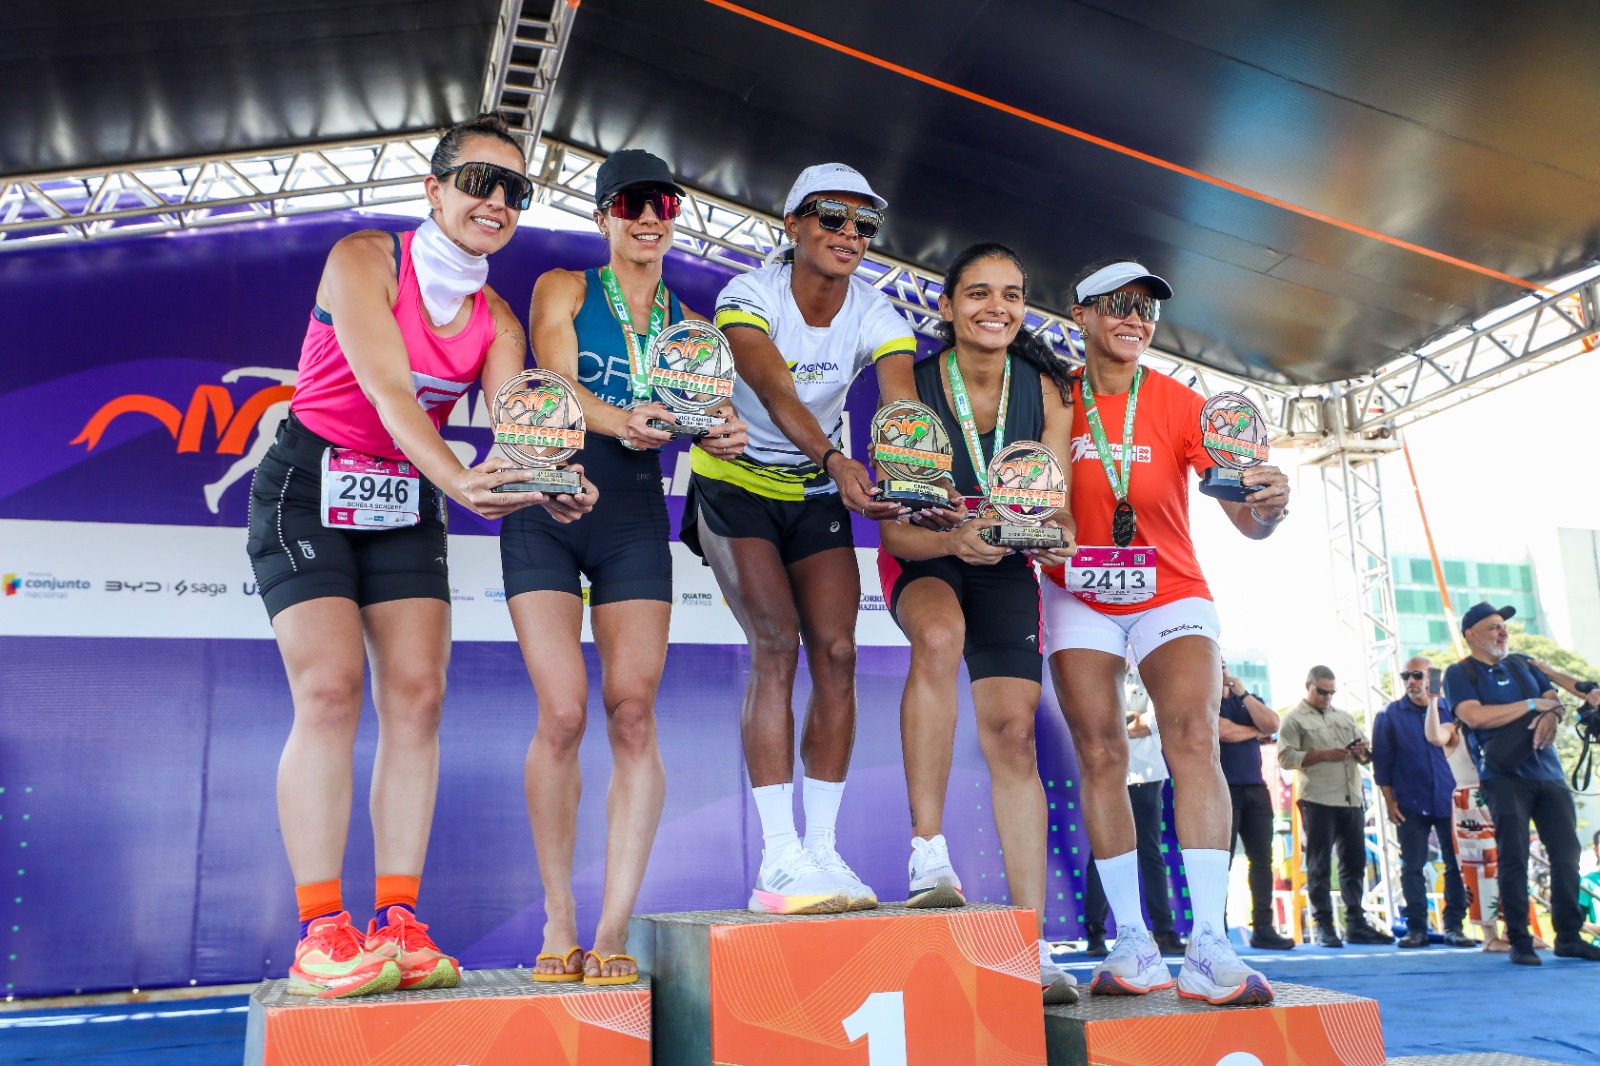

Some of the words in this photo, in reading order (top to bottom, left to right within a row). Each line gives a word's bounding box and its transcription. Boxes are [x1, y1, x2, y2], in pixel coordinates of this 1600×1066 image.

[799, 362, 839, 372] AGENDA
[654, 368, 715, 384] MARATONA
[498, 424, 564, 437] MARATONA
[339, 474, 409, 504] 2946
[25, 577, 91, 590] conjunto
[1081, 570, 1146, 589] 2413
[105, 581, 161, 592] BYD
[191, 583, 227, 596] saga
[243, 582, 260, 595] U
[841, 990, 908, 1066] 1
